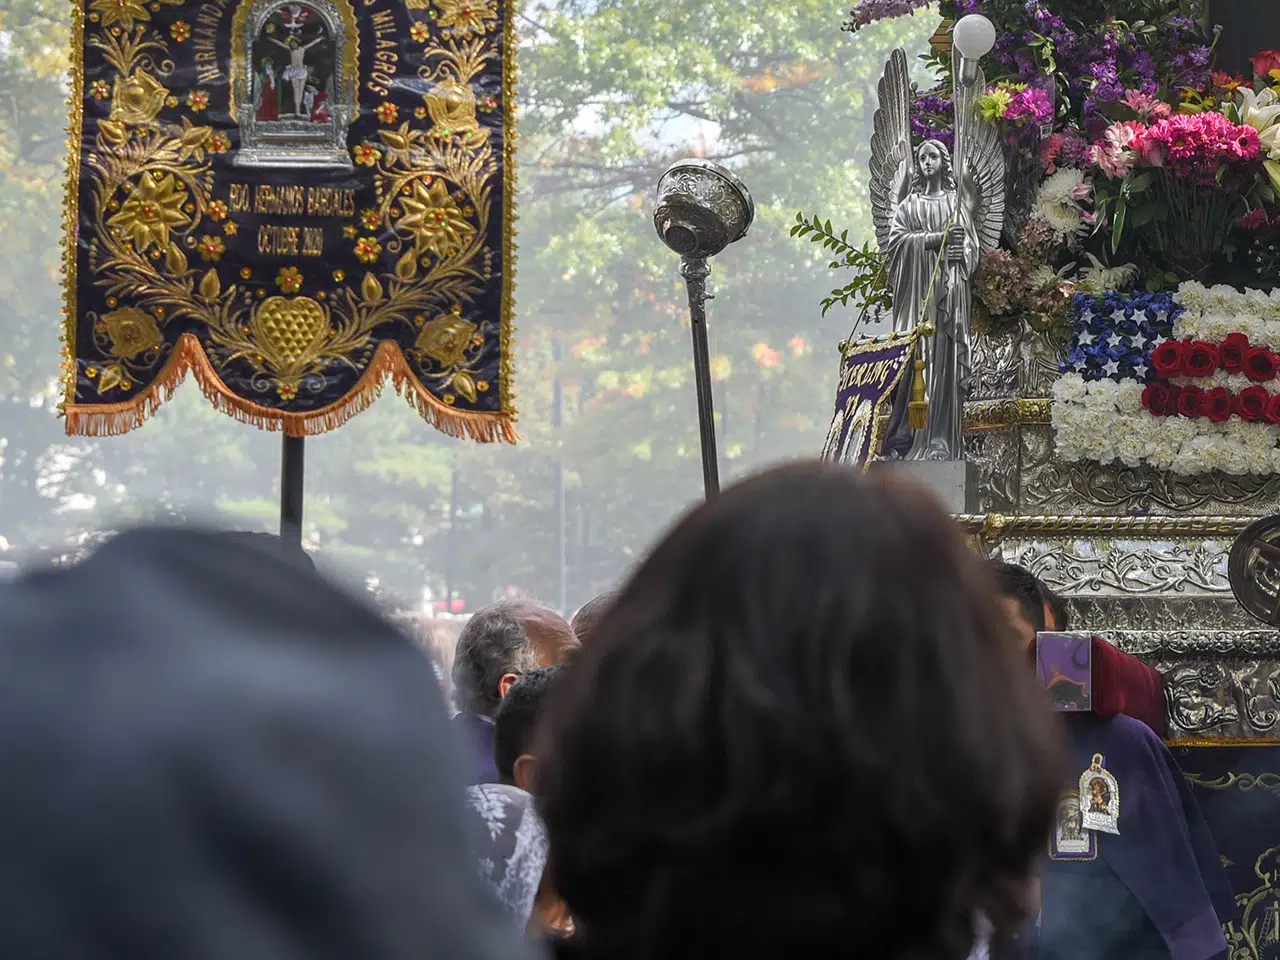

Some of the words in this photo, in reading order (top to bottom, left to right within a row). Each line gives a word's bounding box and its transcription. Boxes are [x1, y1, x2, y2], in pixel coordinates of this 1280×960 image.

[367, 9, 399, 96] MILAGROS
[254, 185, 304, 215] HERMANOS
[258, 224, 300, 255] OCTUBRE
